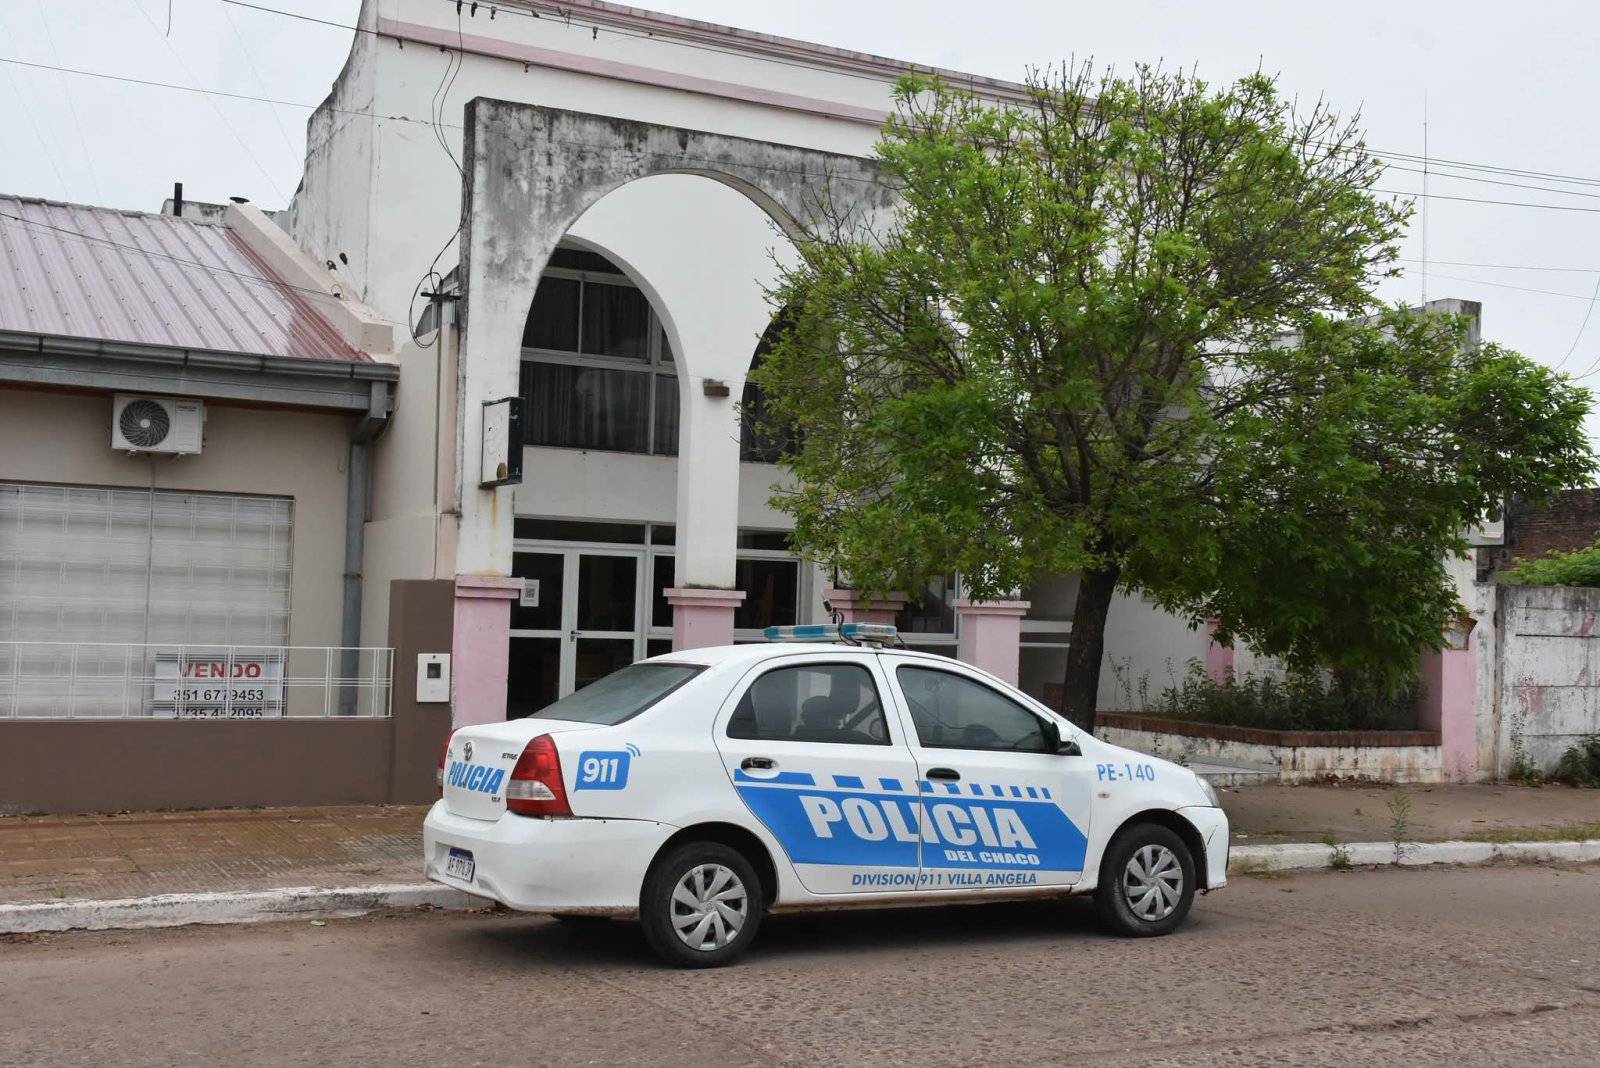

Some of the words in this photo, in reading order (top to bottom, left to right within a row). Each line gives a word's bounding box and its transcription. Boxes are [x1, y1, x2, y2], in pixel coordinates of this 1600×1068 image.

[178, 663, 262, 678] VENDO
[173, 690, 198, 701] 351
[447, 761, 505, 794] POLICIA
[582, 758, 619, 783] 911
[1096, 763, 1155, 781] PE-140
[799, 795, 1038, 849] POLICIA
[944, 850, 978, 863] DEL
[979, 851, 1040, 865] CHACO
[852, 874, 916, 886] DIVISION
[920, 873, 942, 885] 911
[947, 873, 982, 885] VILLA
[986, 873, 1037, 885] ANGELA
